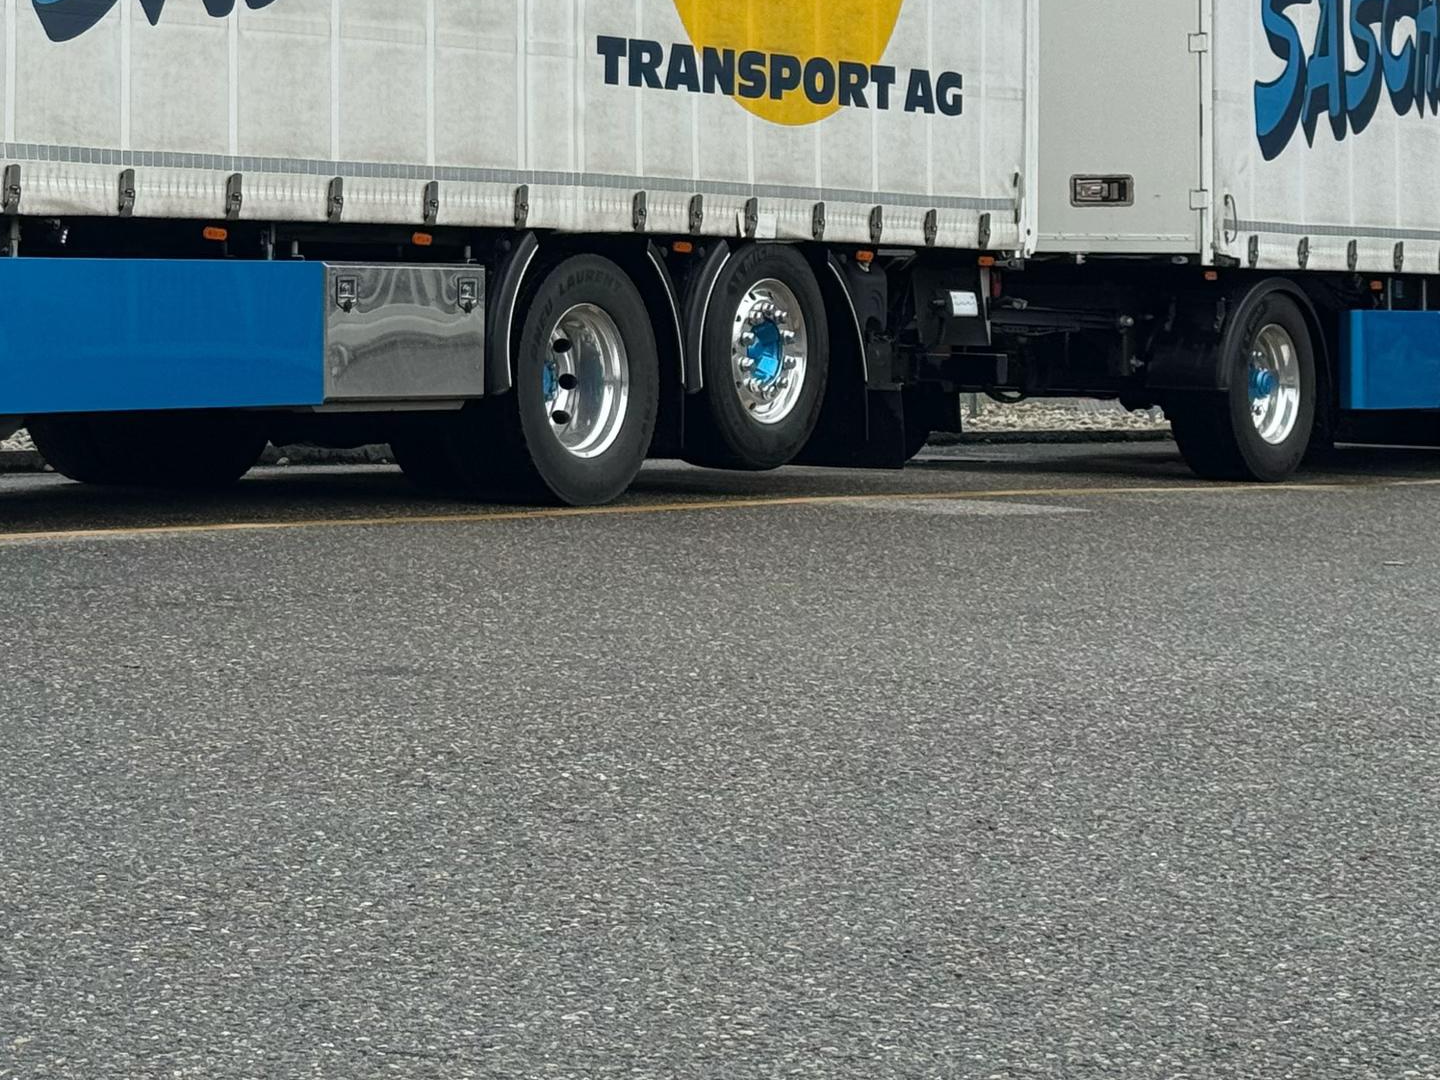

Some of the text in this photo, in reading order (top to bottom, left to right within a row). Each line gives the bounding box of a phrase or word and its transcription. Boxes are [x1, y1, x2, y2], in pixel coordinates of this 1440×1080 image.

[596, 35, 963, 116] TRANSPORT AG
[559, 269, 622, 297] LAURENT
